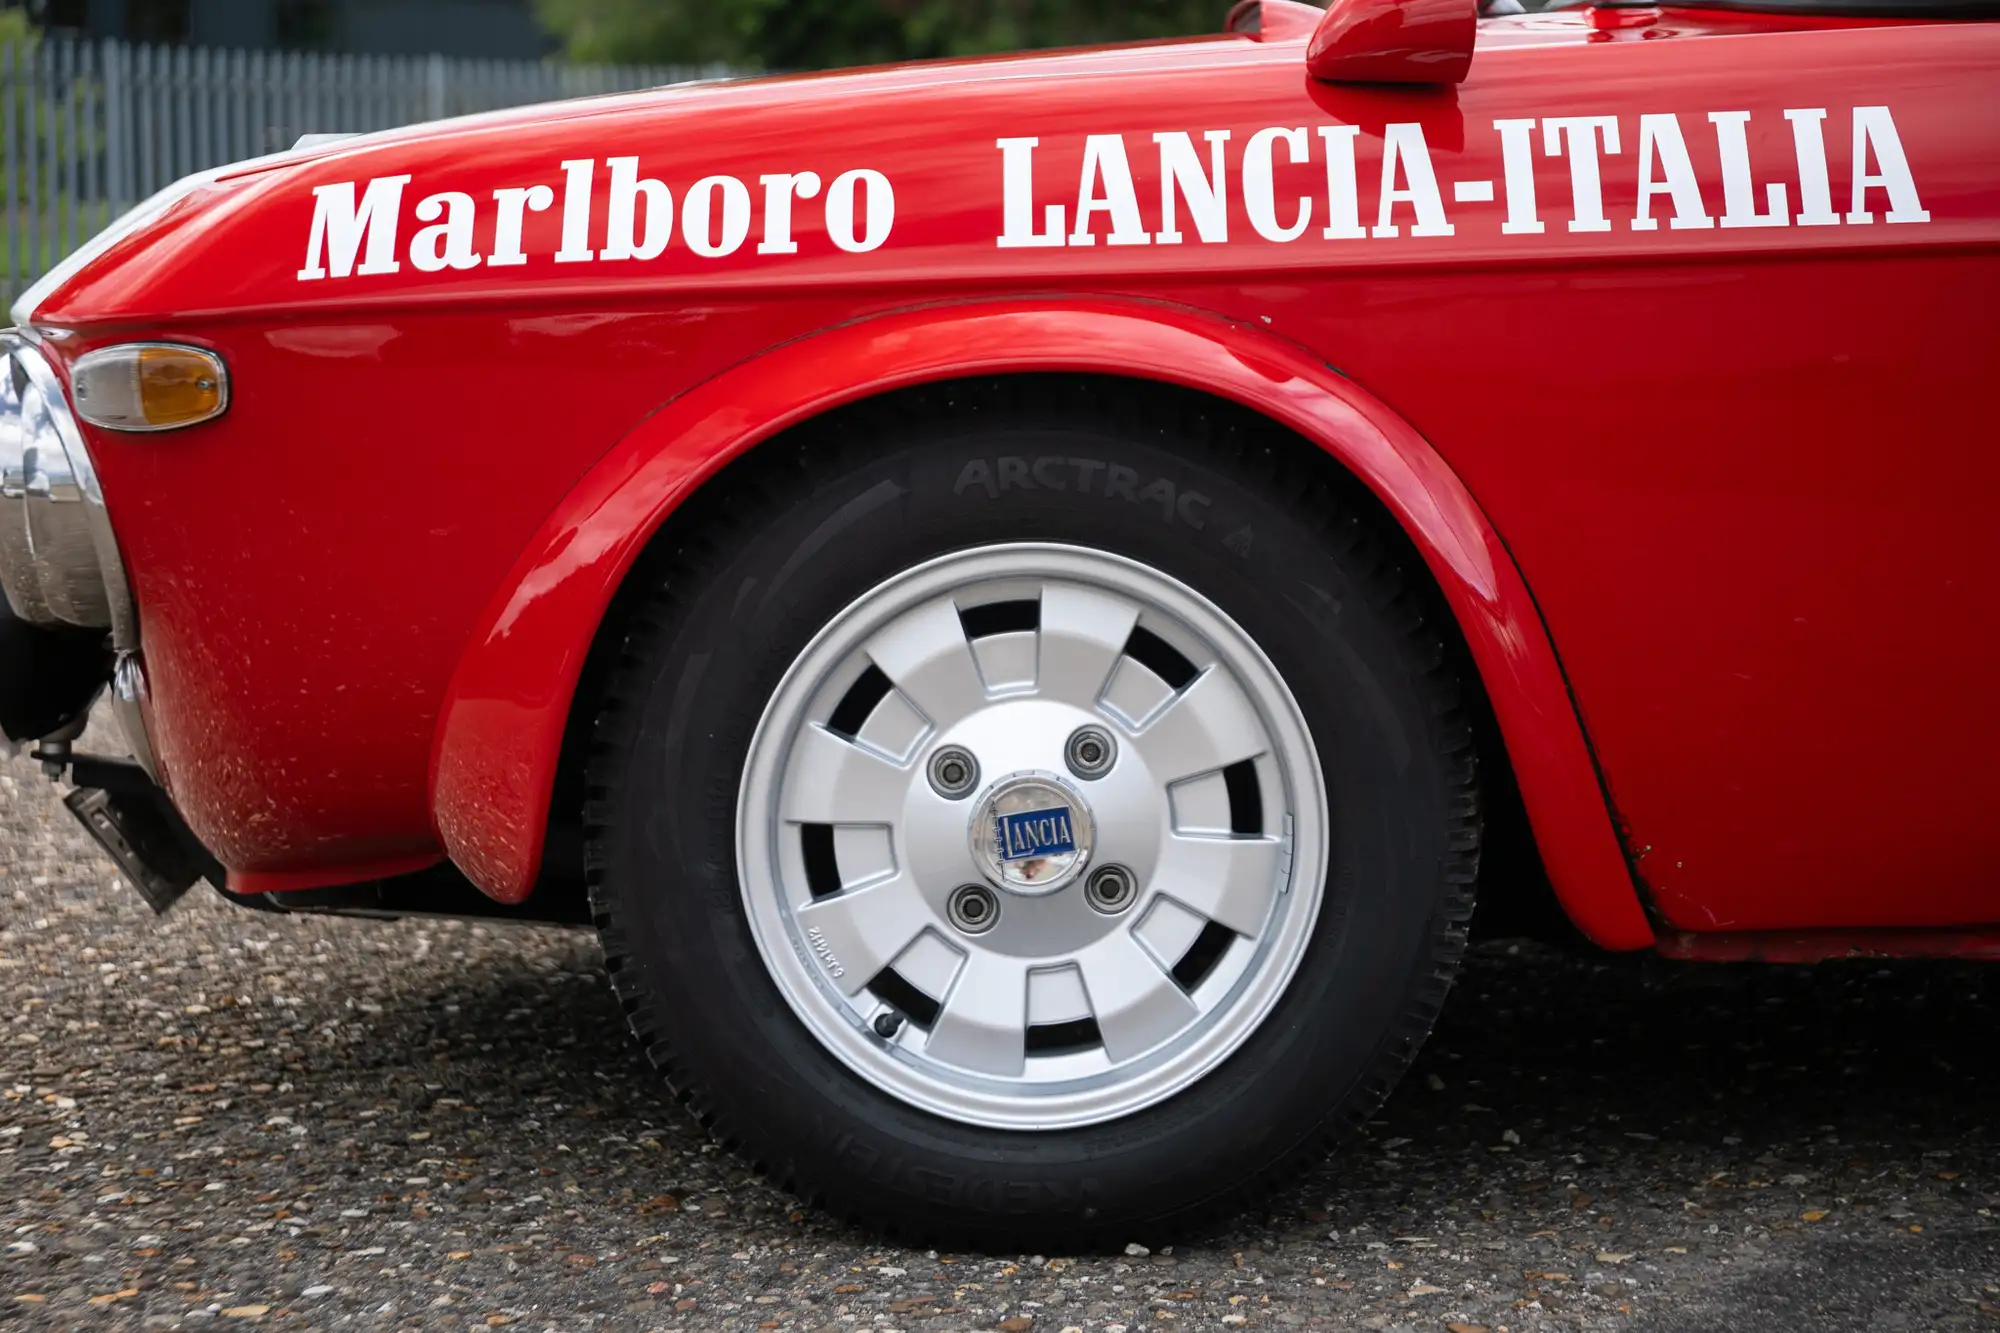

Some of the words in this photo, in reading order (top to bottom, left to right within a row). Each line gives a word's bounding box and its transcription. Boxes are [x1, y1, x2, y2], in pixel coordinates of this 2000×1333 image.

[297, 155, 896, 281] Marlboro
[996, 105, 1931, 248] LANCIA-ITALIA
[953, 456, 1213, 531] ARCTRAC
[1003, 815, 1072, 859] LANCIA
